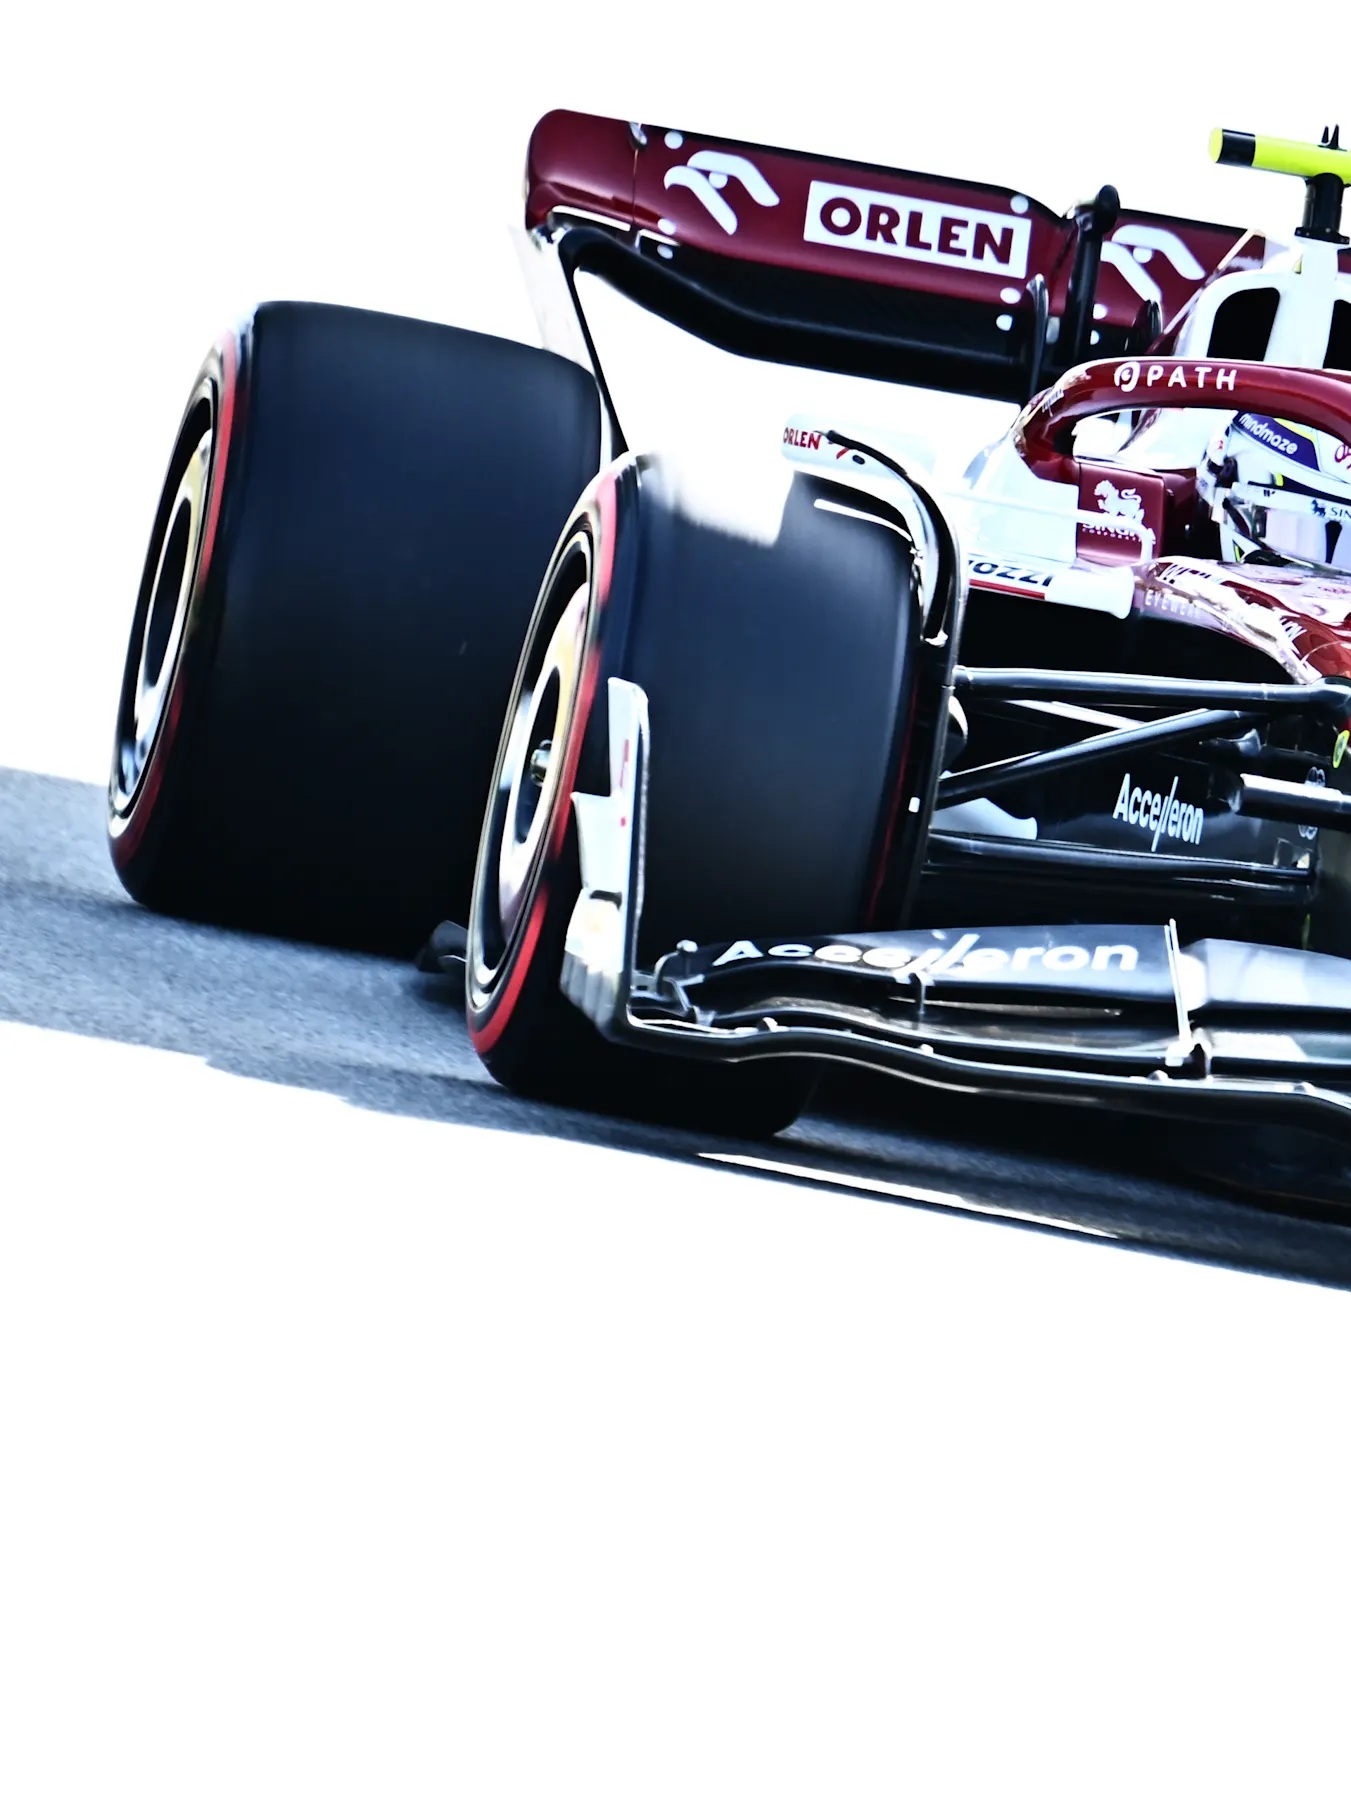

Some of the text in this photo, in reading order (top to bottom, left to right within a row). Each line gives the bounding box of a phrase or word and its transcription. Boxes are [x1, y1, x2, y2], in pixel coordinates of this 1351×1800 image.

[819, 196, 1014, 266] ORLEN
[1146, 365, 1237, 391] PATH
[783, 427, 822, 451] ORLEN
[1239, 412, 1298, 455] mindmaze
[711, 934, 1140, 986] Accelleron
